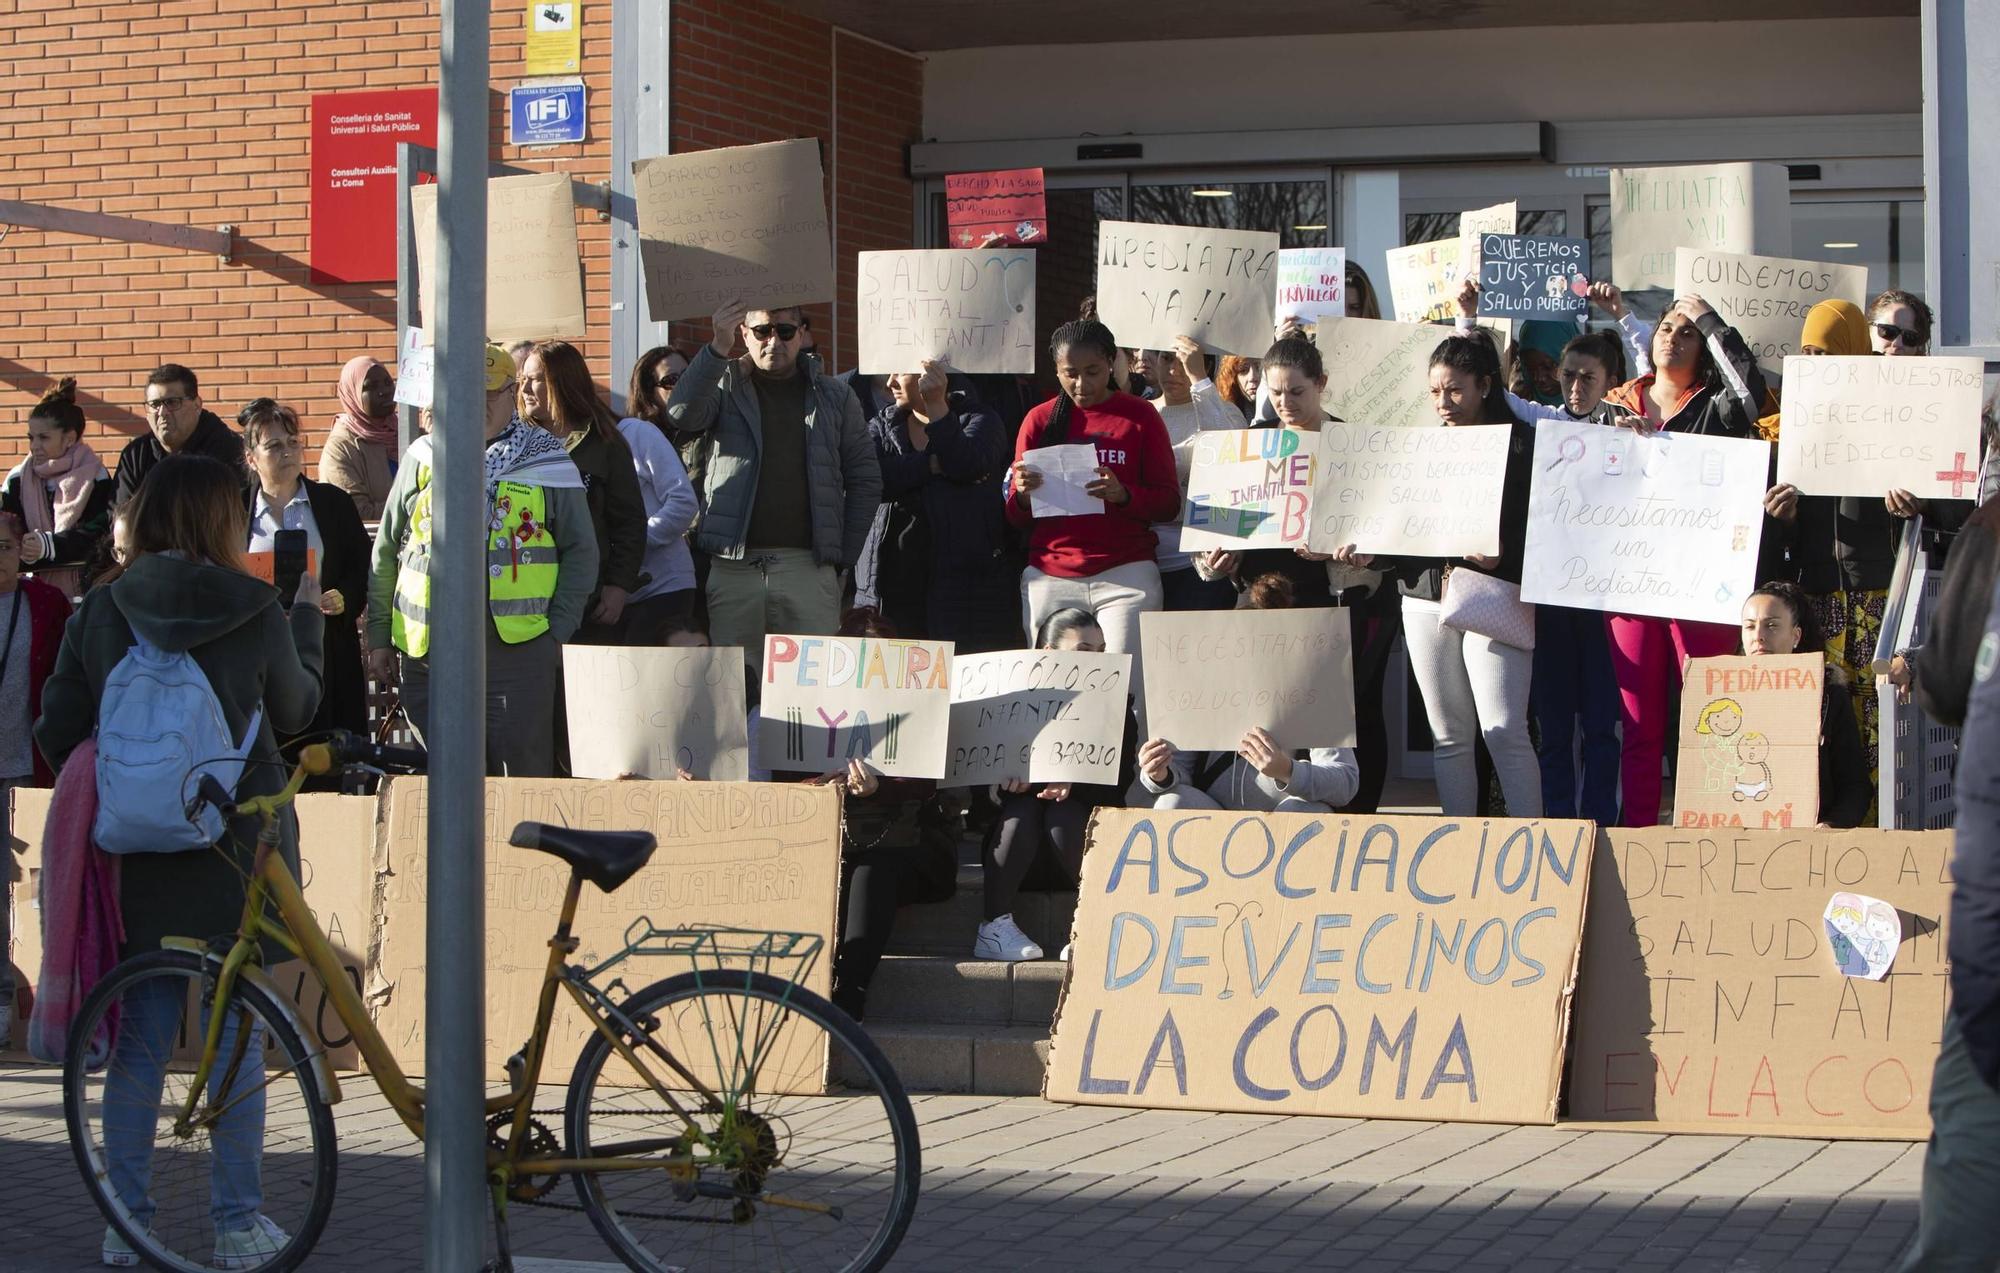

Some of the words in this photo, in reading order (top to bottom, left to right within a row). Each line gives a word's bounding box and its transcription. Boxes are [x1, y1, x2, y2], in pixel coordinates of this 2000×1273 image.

[331, 114, 372, 123] Conselleria
[373, 113, 383, 121] de
[384, 112, 411, 121] Sanitat
[529, 99, 566, 120] IFI
[331, 124, 365, 135] Universal
[371, 123, 390, 133] Salut
[392, 121, 420, 132] Pública
[331, 166, 370, 177] Consultori
[342, 179, 364, 187] Coma
[647, 165, 720, 188] BARRIO
[650, 229, 737, 254] BARRIO
[1483, 234, 1581, 260] QUEREMOS
[864, 255, 978, 296] SALUD
[1521, 280, 1535, 296] Y
[1690, 256, 1832, 293] CUIDEMOS
[870, 297, 981, 325] MENTAL
[1141, 288, 1226, 325] YA!!
[1484, 291, 1532, 311] SALUD
[1720, 296, 1810, 319] NUESTRO
[1333, 325, 1438, 412] NECESITAMOS
[1788, 357, 1859, 393] POR
[1876, 363, 1982, 392] NUESTROS
[1794, 401, 1943, 428] DERECHOS
[1195, 428, 1300, 467] SALUD
[1328, 425, 1460, 456] QUEREMOS
[1799, 434, 1935, 470] MÉDICOS
[1097, 450, 1126, 465] TER
[1327, 460, 1415, 481] MISMOS
[1426, 460, 1498, 480] DERECHOS
[1339, 487, 1365, 504] EN
[1389, 486, 1443, 506] SALUD
[1460, 486, 1499, 508] QUE
[1188, 494, 1230, 526] EN
[1238, 501, 1281, 540] EL
[1324, 513, 1385, 537] OTROS
[1402, 513, 1484, 539] BARRIOS
[1611, 539, 1655, 558] un
[767, 636, 948, 690] PEDIATRA
[1154, 632, 1342, 665] NECESITAMOS
[957, 654, 1121, 699] PSICÓLOGO
[1166, 687, 1319, 713] SOLUCIONES
[977, 699, 1080, 731] INFANTIL
[953, 742, 1005, 777] PARA
[1018, 741, 1037, 765] EL
[1049, 740, 1116, 767] BARRIO
[517, 785, 616, 834] UNA
[1681, 809, 1745, 828] PARA
[1624, 838, 1869, 900] DERECHO
[1897, 845, 1921, 886] A
[1629, 915, 1818, 962] SALUD
[1104, 911, 1218, 996] DE
[1077, 1007, 1189, 1096] LA
[1232, 1003, 1479, 1103] COMA
[1707, 1055, 1780, 1117] LA
[1805, 1055, 1914, 1116] CO
